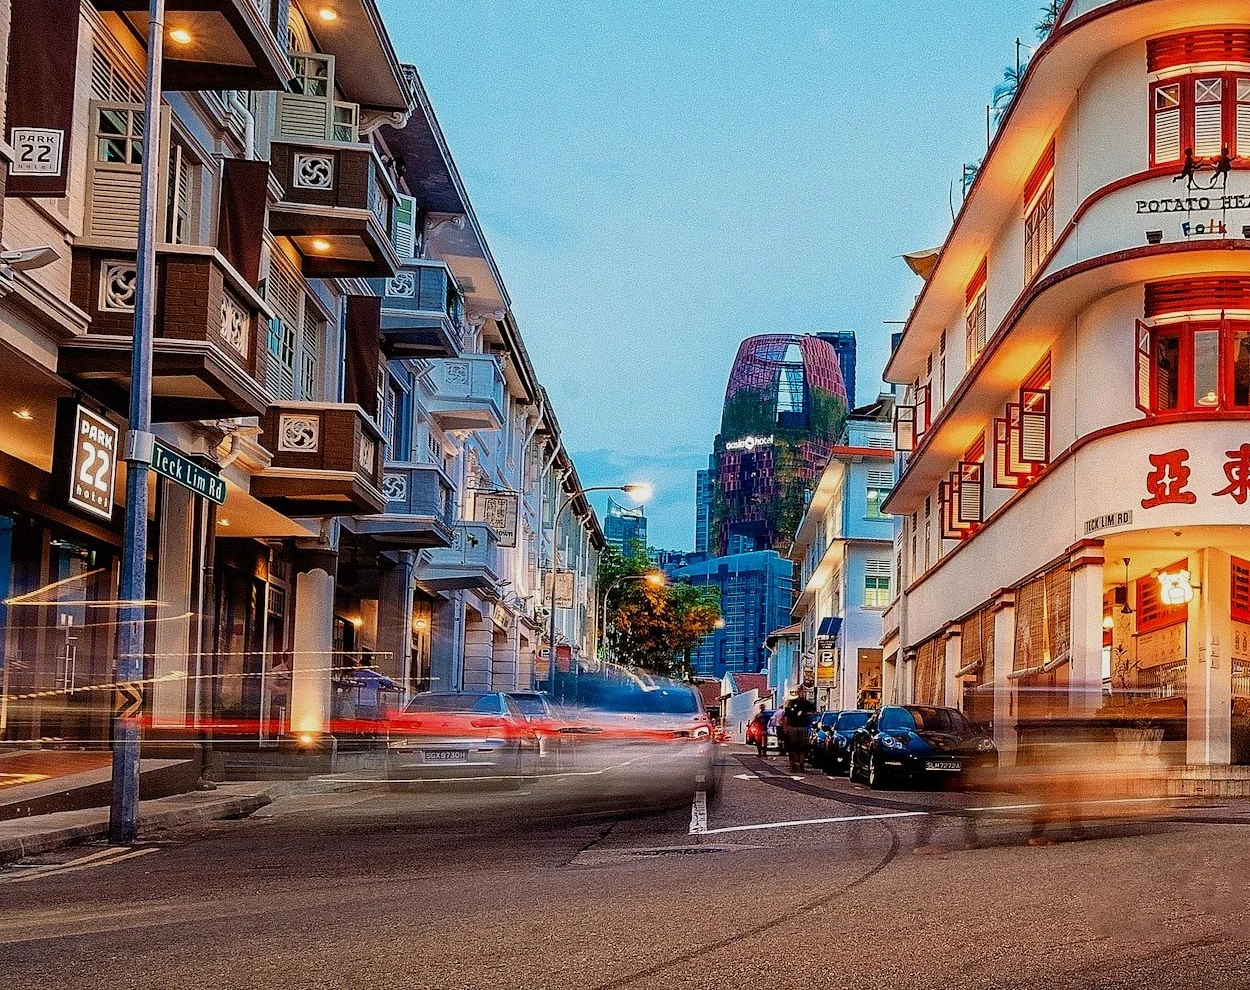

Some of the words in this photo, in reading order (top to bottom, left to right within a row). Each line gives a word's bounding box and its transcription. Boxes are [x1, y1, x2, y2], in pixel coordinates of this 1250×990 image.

[19, 134, 55, 144] PARK
[21, 144, 51, 162] 22
[1136, 197, 1210, 214] POTATO
[1182, 218, 1227, 236] Folk
[81, 419, 113, 451] PARK
[754, 434, 774, 446] hotel
[79, 441, 110, 492] 22
[155, 447, 182, 480] Teck
[186, 464, 206, 491] Lim
[208, 477, 222, 500] Rd
[76, 484, 108, 508] hotel
[1086, 519, 1099, 532] TECK
[1101, 514, 1115, 528] LIM
[1117, 512, 1129, 524] RD
